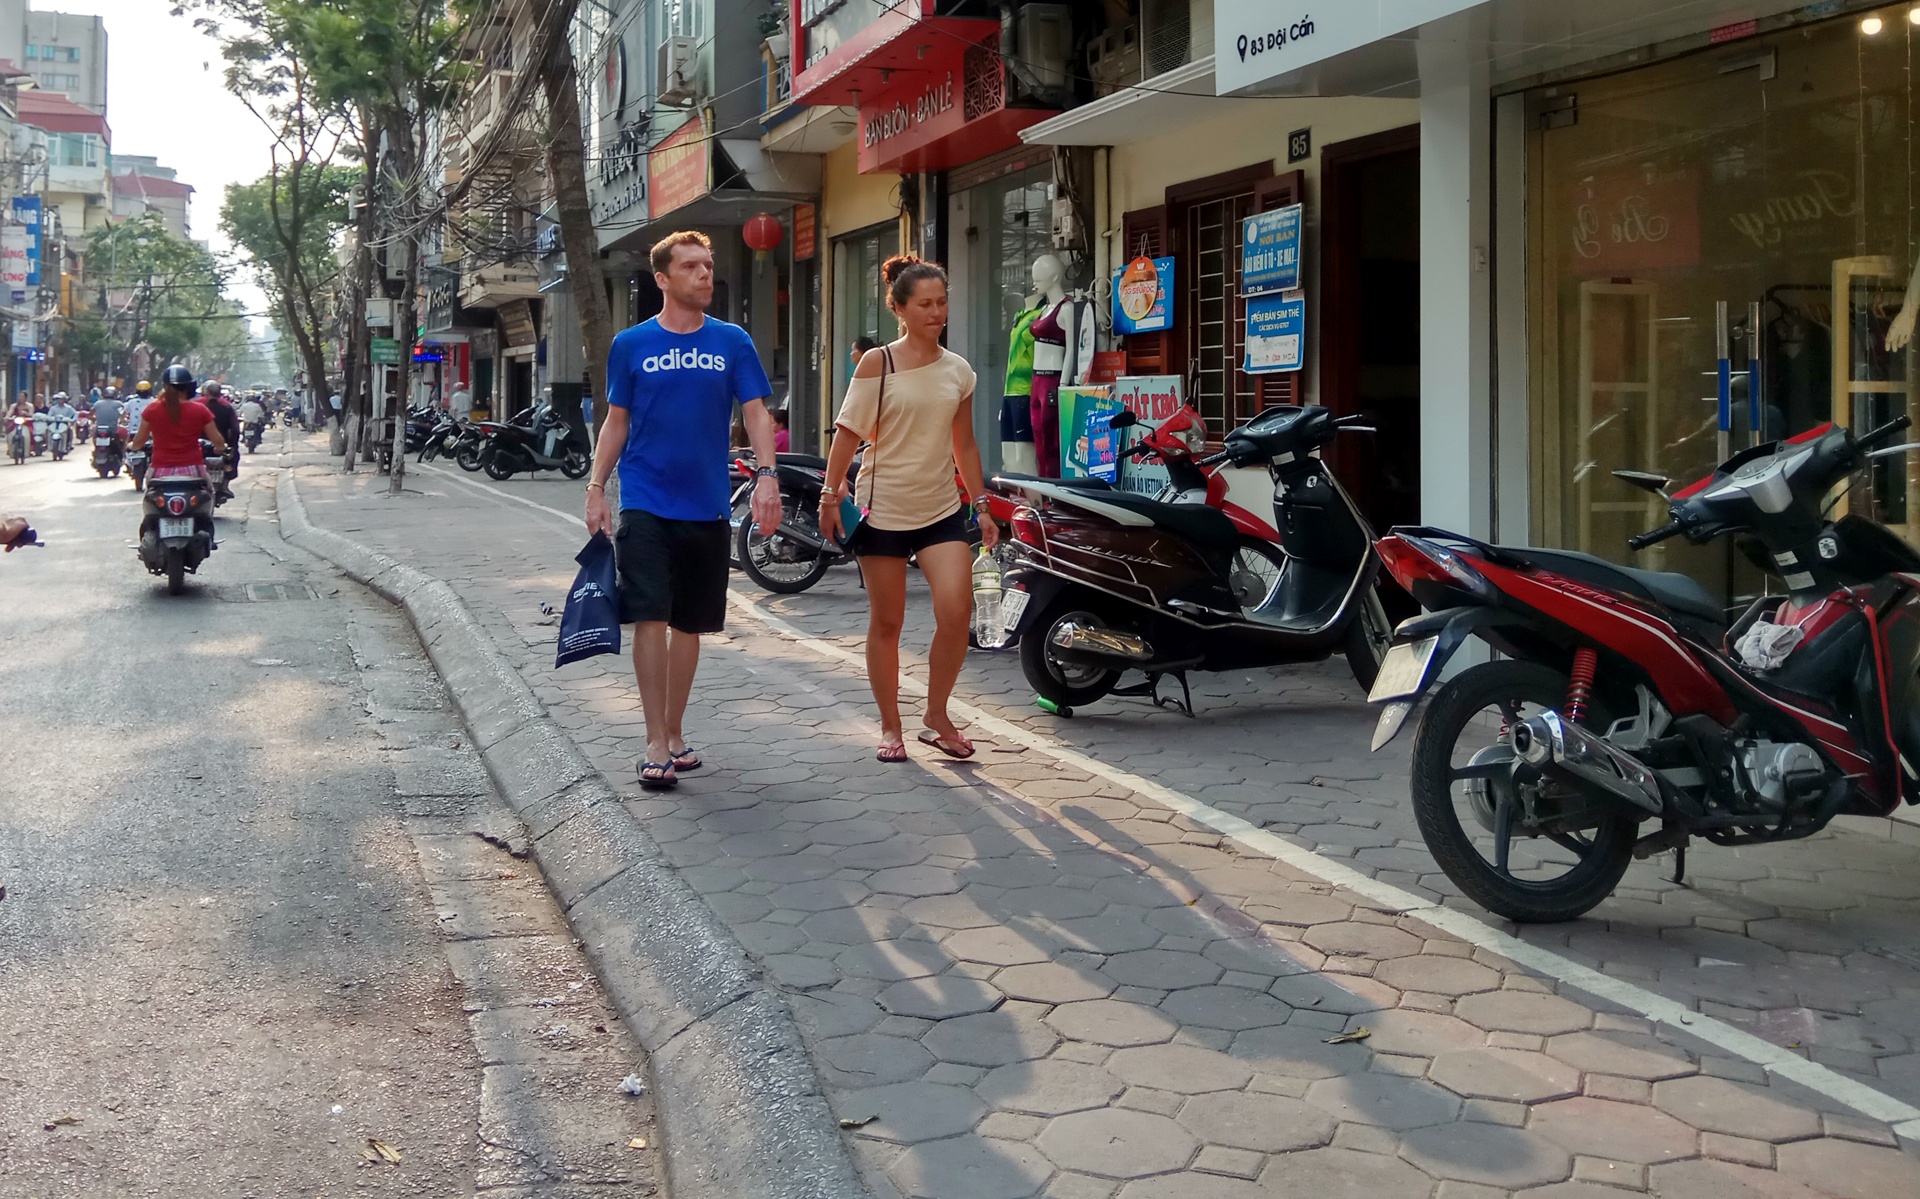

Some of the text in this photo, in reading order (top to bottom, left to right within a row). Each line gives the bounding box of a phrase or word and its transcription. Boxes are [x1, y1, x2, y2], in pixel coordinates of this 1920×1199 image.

[1250, 14, 1314, 56] 83 Đội Cấn
[865, 112, 883, 148] BÁN
[883, 101, 909, 140] BUÔN
[917, 83, 939, 123] BÁN
[940, 70, 953, 112] LẺ
[1291, 134, 1307, 157] 85
[1265, 310, 1276, 321] BÁN
[1277, 309, 1287, 319] SIM
[1288, 305, 1300, 317] THẺ
[642, 347, 726, 373] adidas
[1151, 385, 1179, 420] KHÔ
